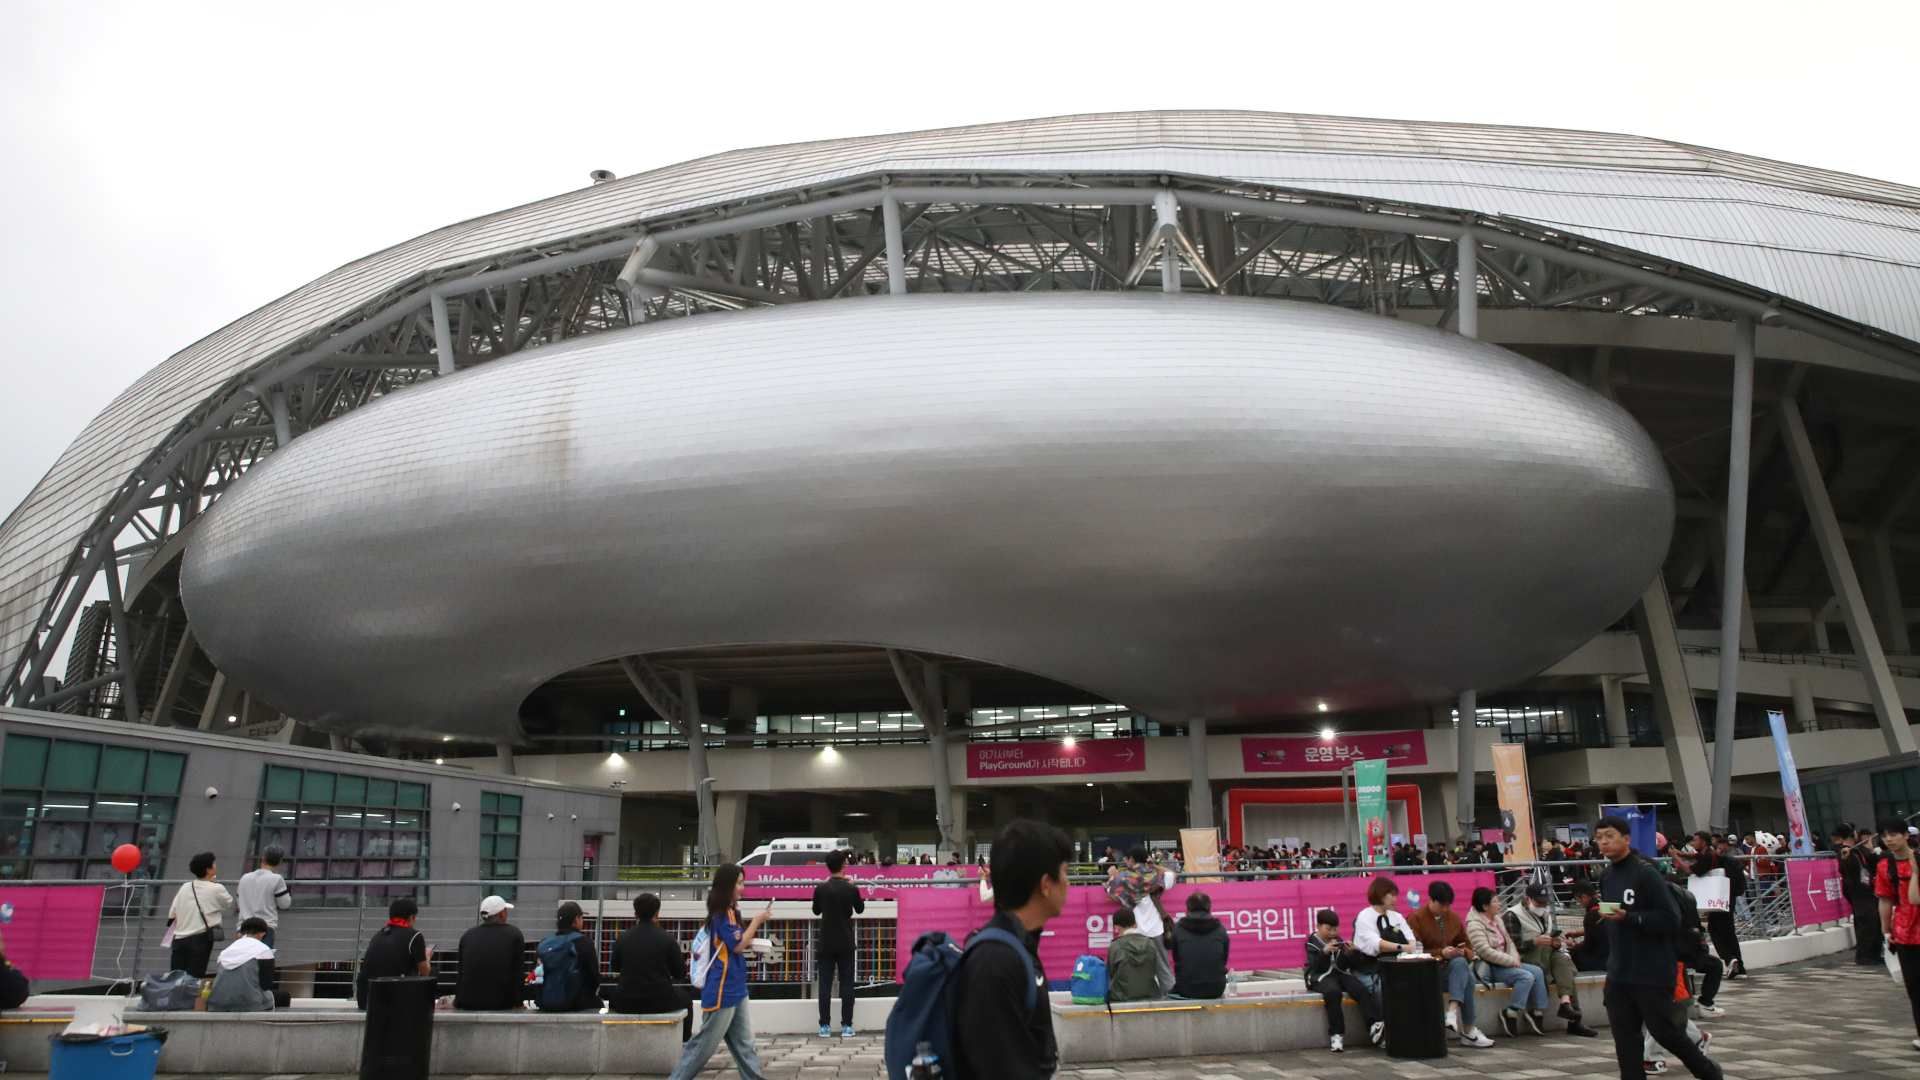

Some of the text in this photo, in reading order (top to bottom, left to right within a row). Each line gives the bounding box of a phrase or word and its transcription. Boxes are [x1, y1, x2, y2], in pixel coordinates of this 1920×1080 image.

[1305, 745, 1366, 762] 운영 부스
[1623, 888, 1635, 905] C
